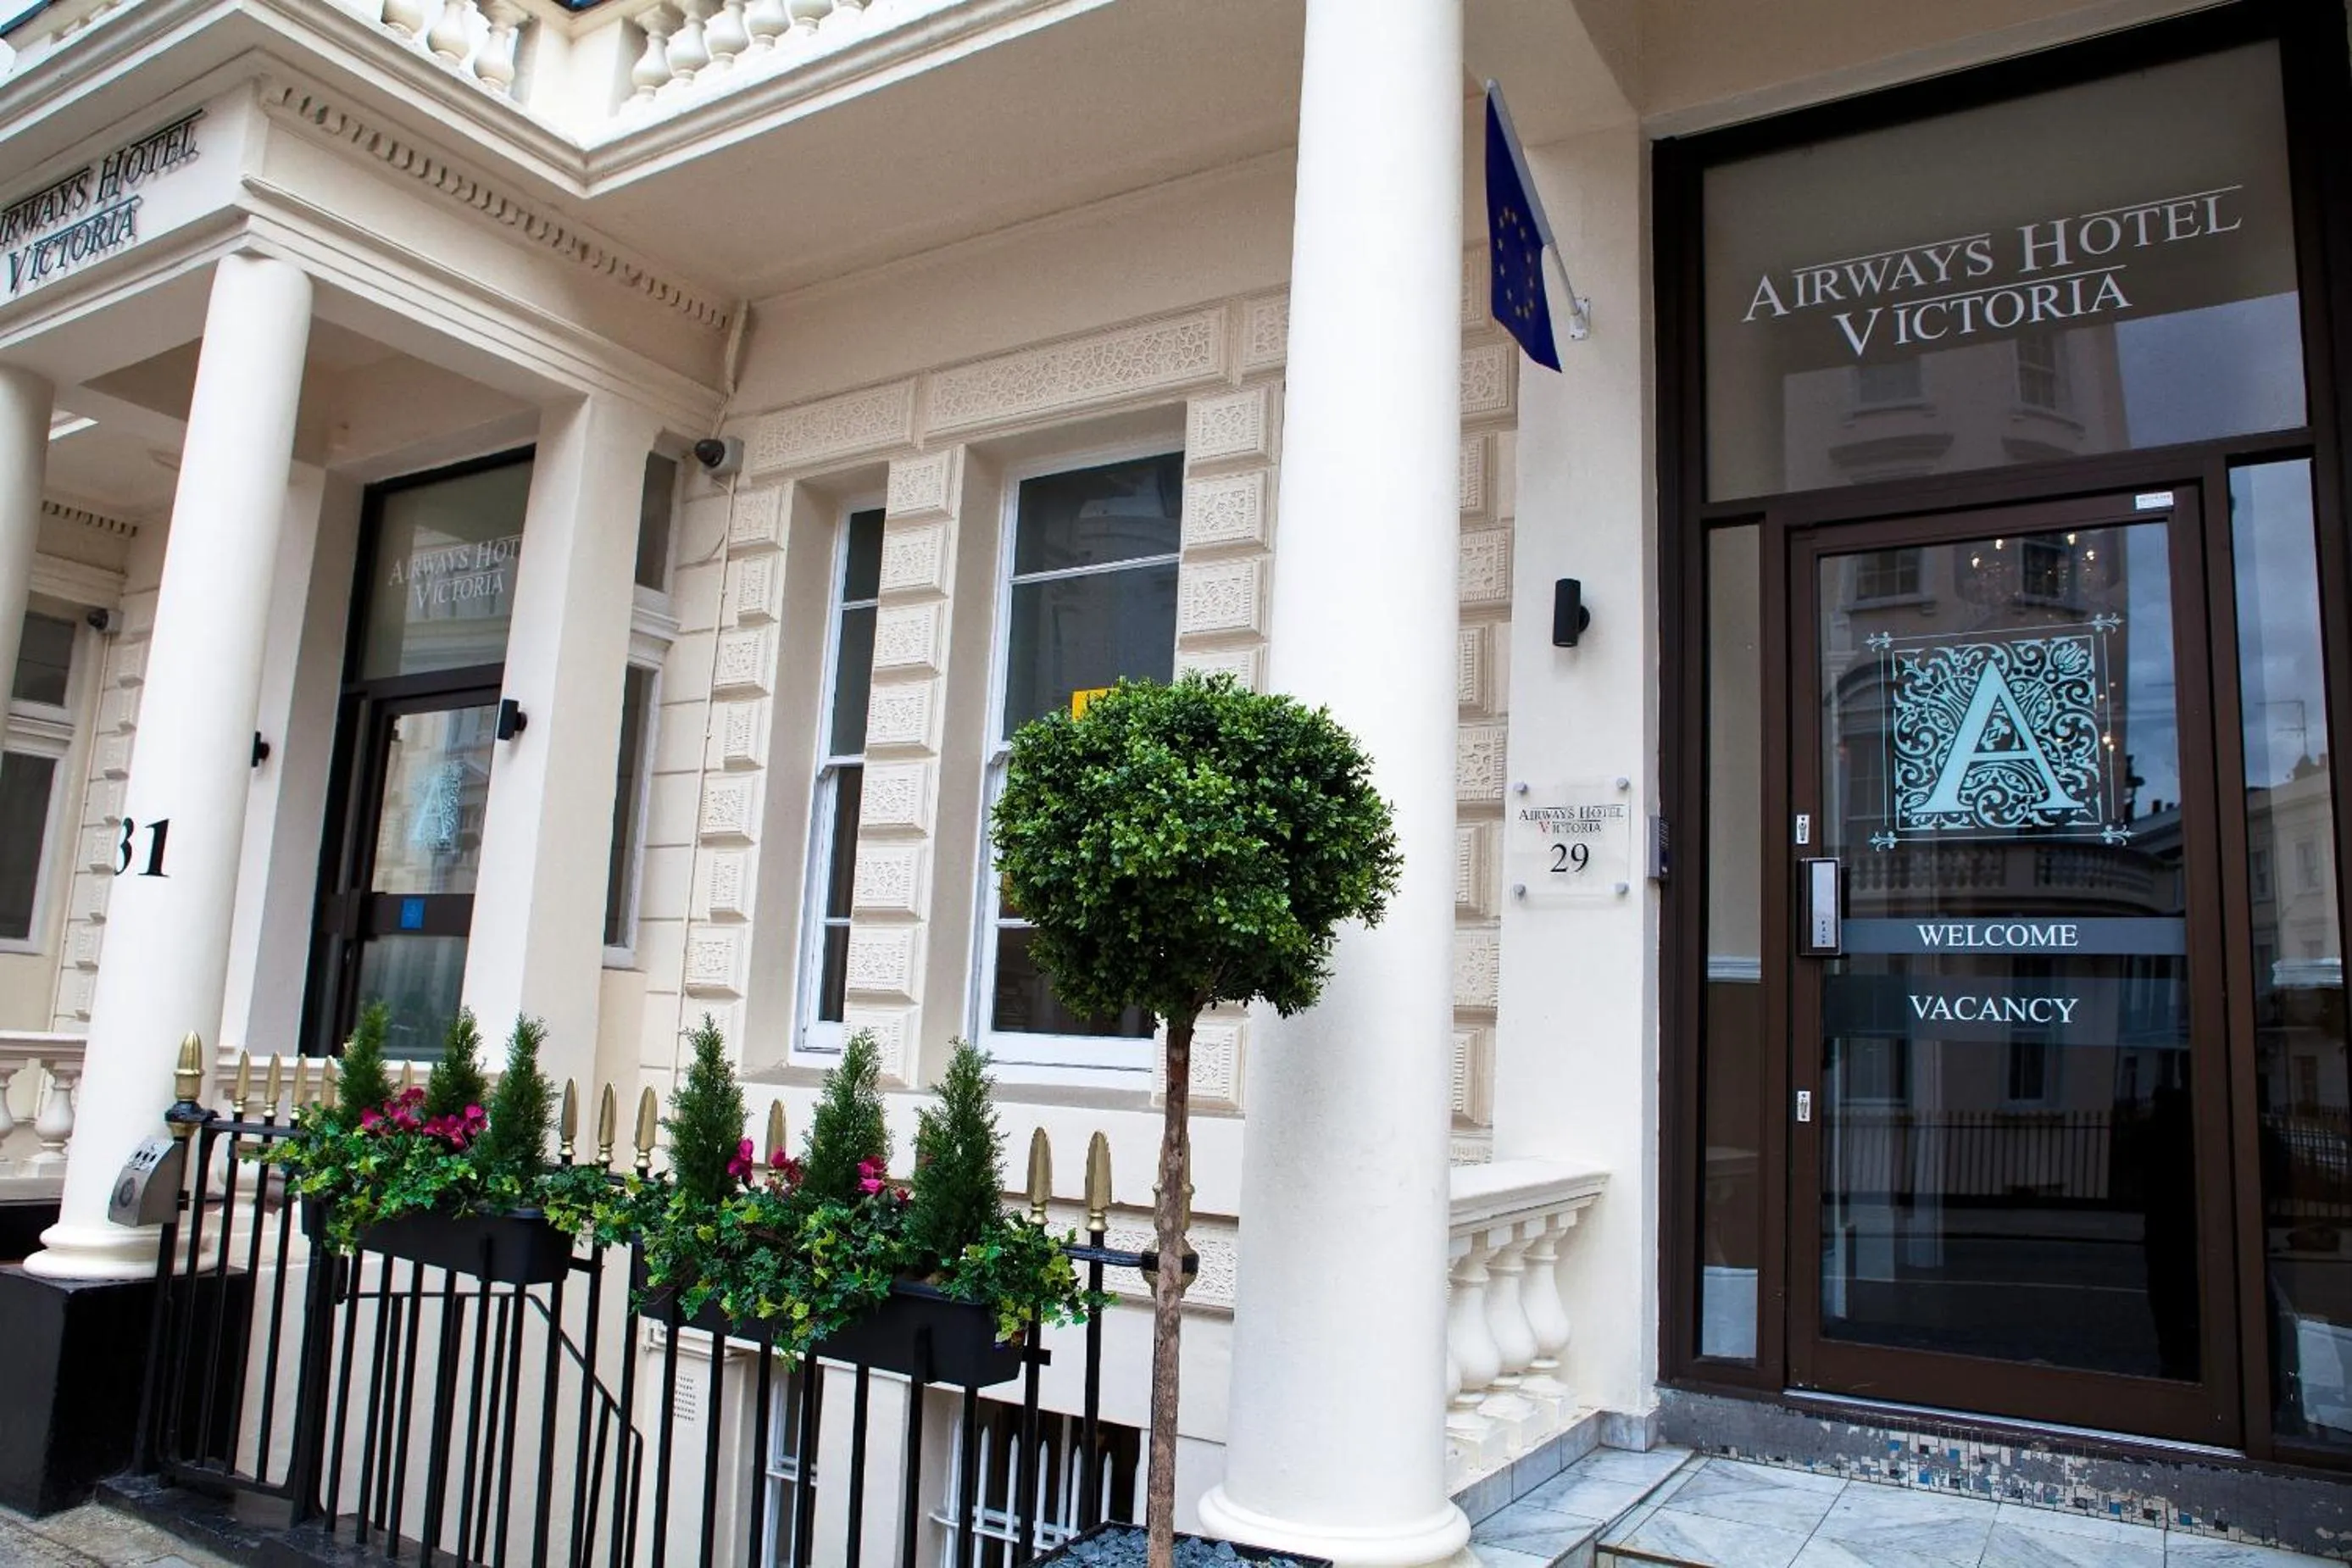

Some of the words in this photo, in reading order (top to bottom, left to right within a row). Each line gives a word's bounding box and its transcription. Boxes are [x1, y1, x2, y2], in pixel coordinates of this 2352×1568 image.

[95, 121, 197, 203] HOTEL
[8, 203, 138, 292] VICTORIA
[1742, 237, 1994, 322] AIRWAYS
[2016, 196, 2243, 273] HOTEL
[1832, 272, 2133, 357] VICTORIA
[475, 539, 521, 568] HOT
[415, 572, 503, 609] VICTORIA
[1911, 659, 2086, 814] A
[1519, 808, 1575, 820] AIRWAYS
[1580, 806, 1624, 819] HOTEL
[1538, 820, 1602, 834] VICTORIA
[1549, 842, 1590, 873] 29
[1916, 924, 2080, 947] WELCOME
[1909, 994, 2080, 1024] VACANCY
